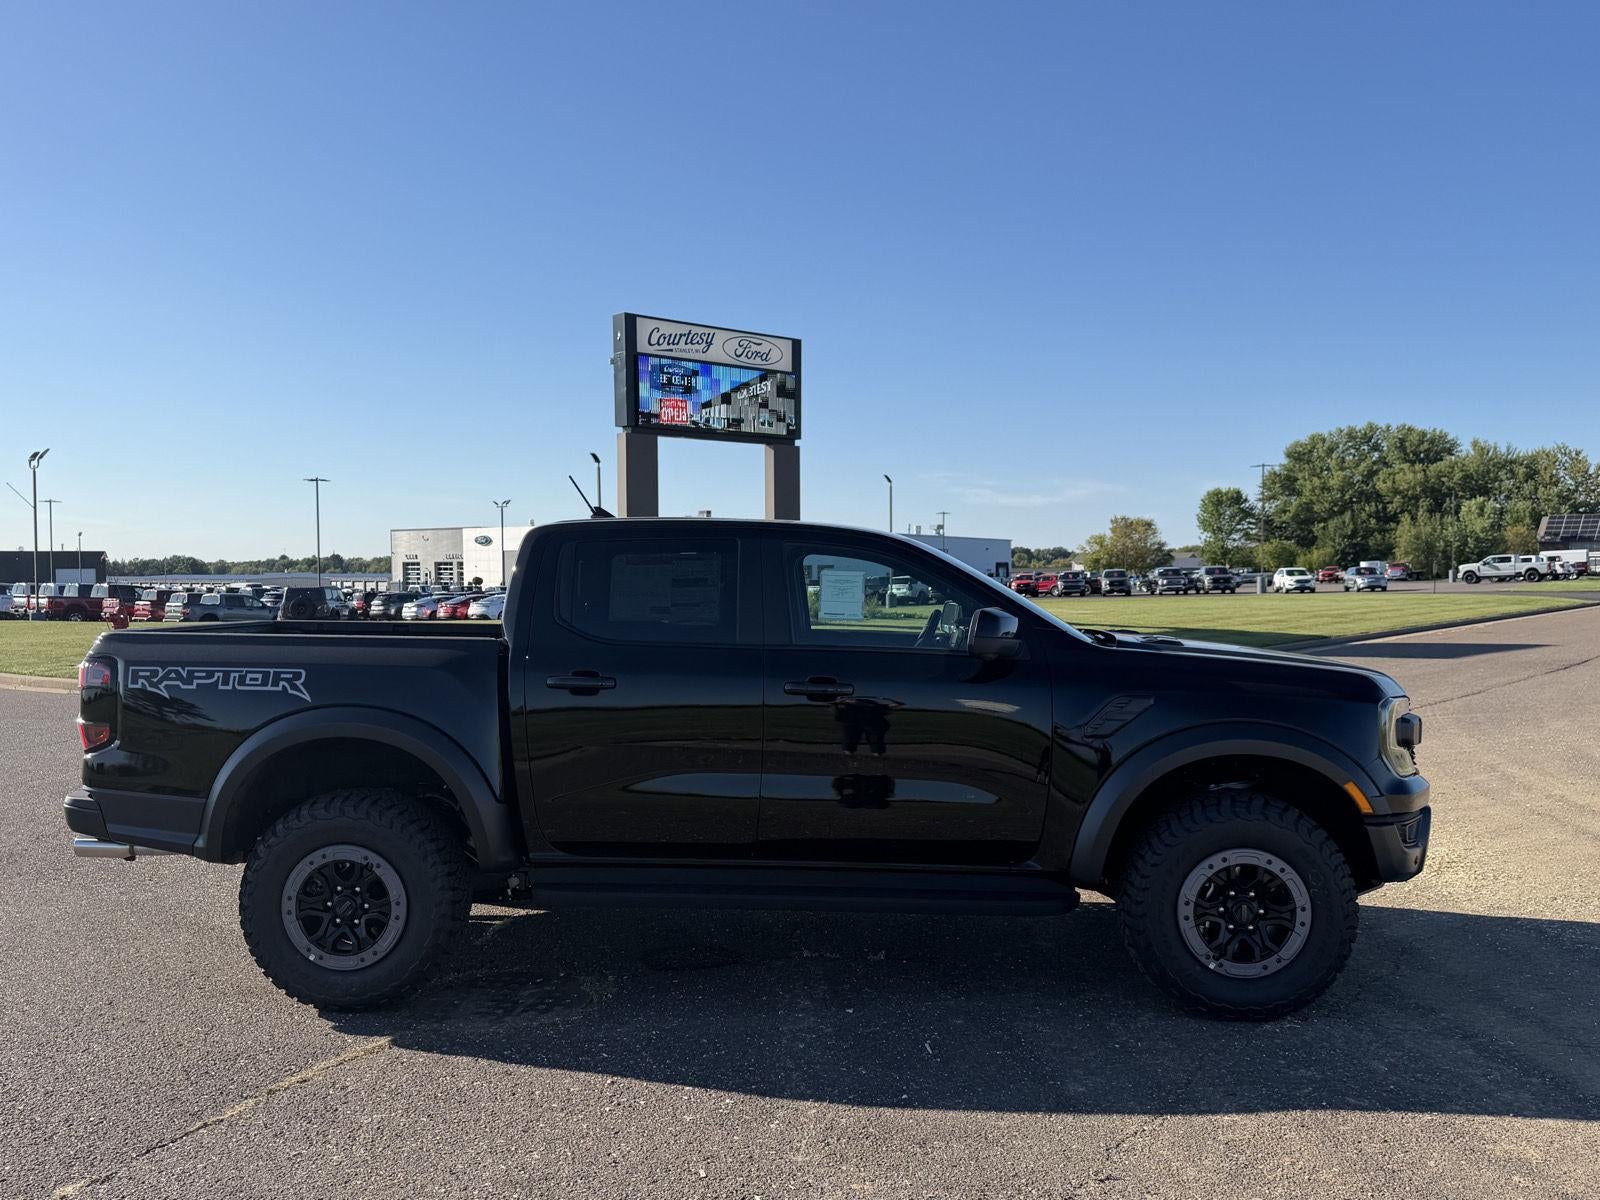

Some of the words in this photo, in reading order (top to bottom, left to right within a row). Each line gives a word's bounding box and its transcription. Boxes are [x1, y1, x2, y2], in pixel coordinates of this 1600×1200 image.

[647, 327, 715, 354] Courtesy
[733, 338, 772, 362] Ford
[737, 378, 773, 400] CORTESY
[129, 666, 311, 703] RAPTOR
